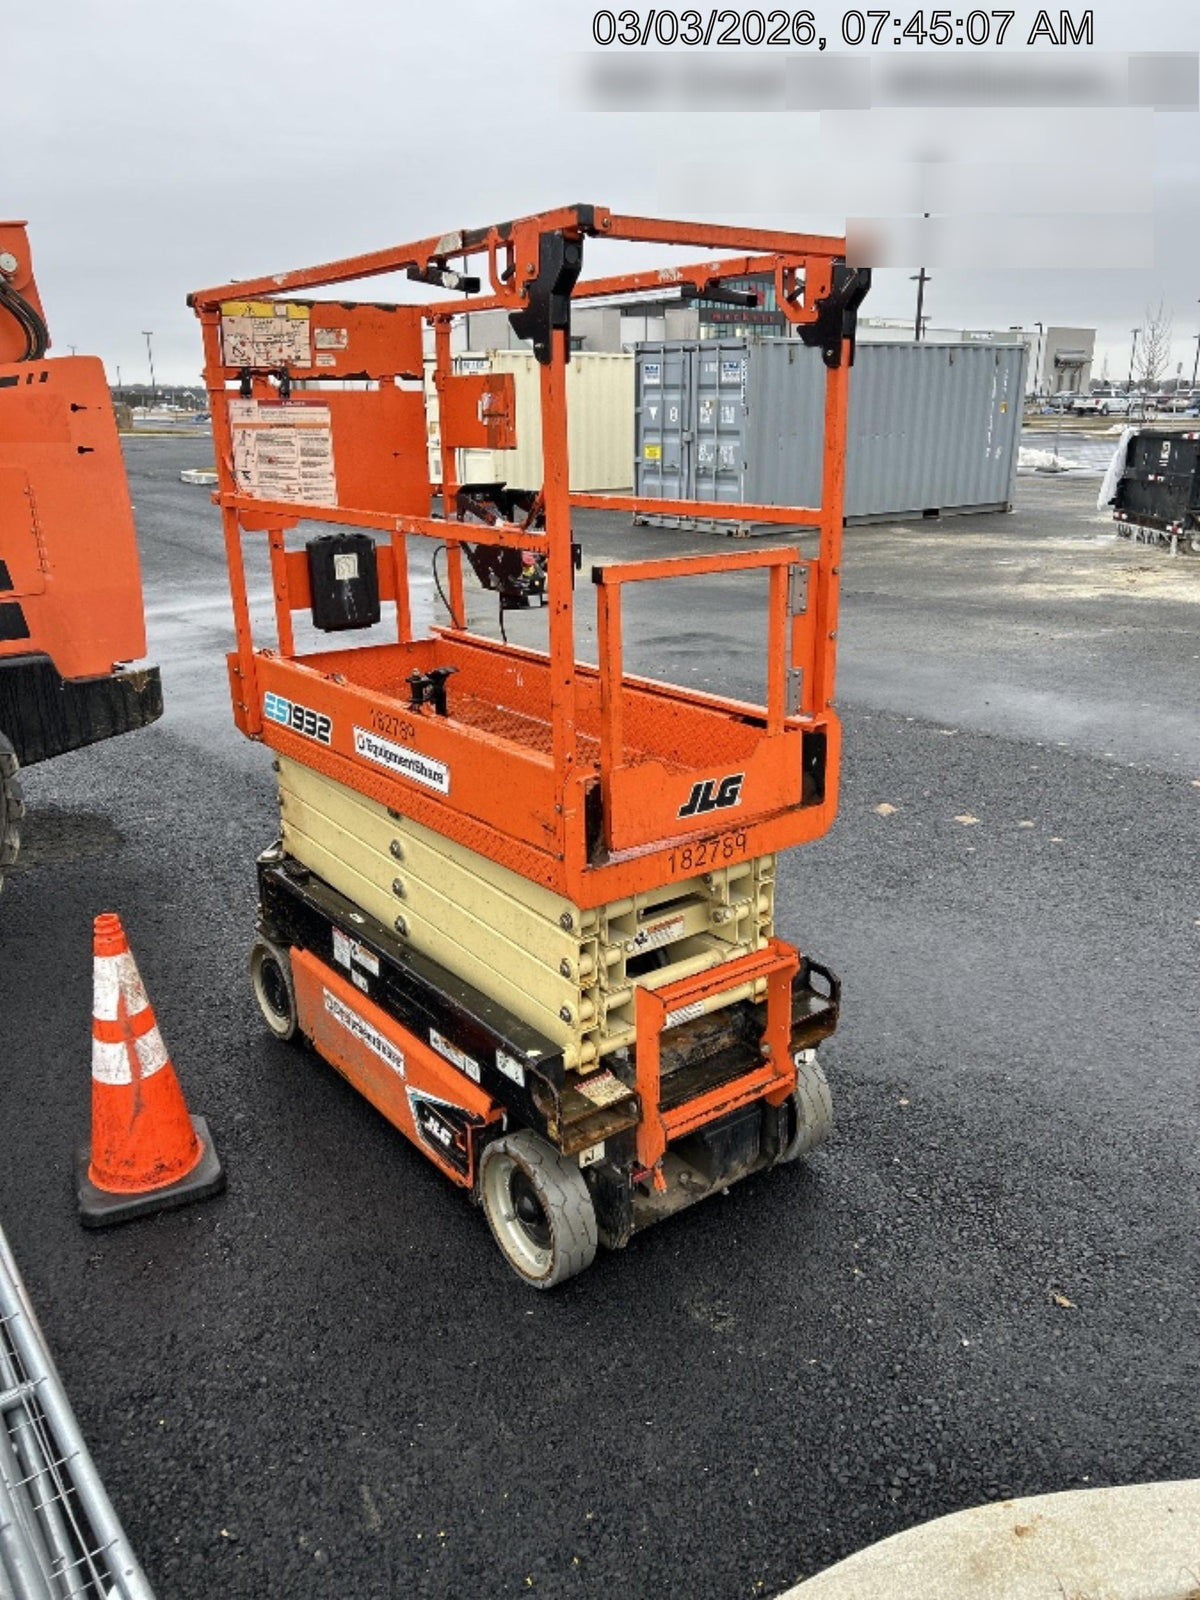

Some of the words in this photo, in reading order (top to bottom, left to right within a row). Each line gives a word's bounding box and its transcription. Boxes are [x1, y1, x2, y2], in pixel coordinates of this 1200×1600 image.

[264, 691, 332, 745] ES1932
[677, 773, 746, 819] JLG
[667, 833, 747, 874] 182789
[424, 1115, 452, 1146] JLG
